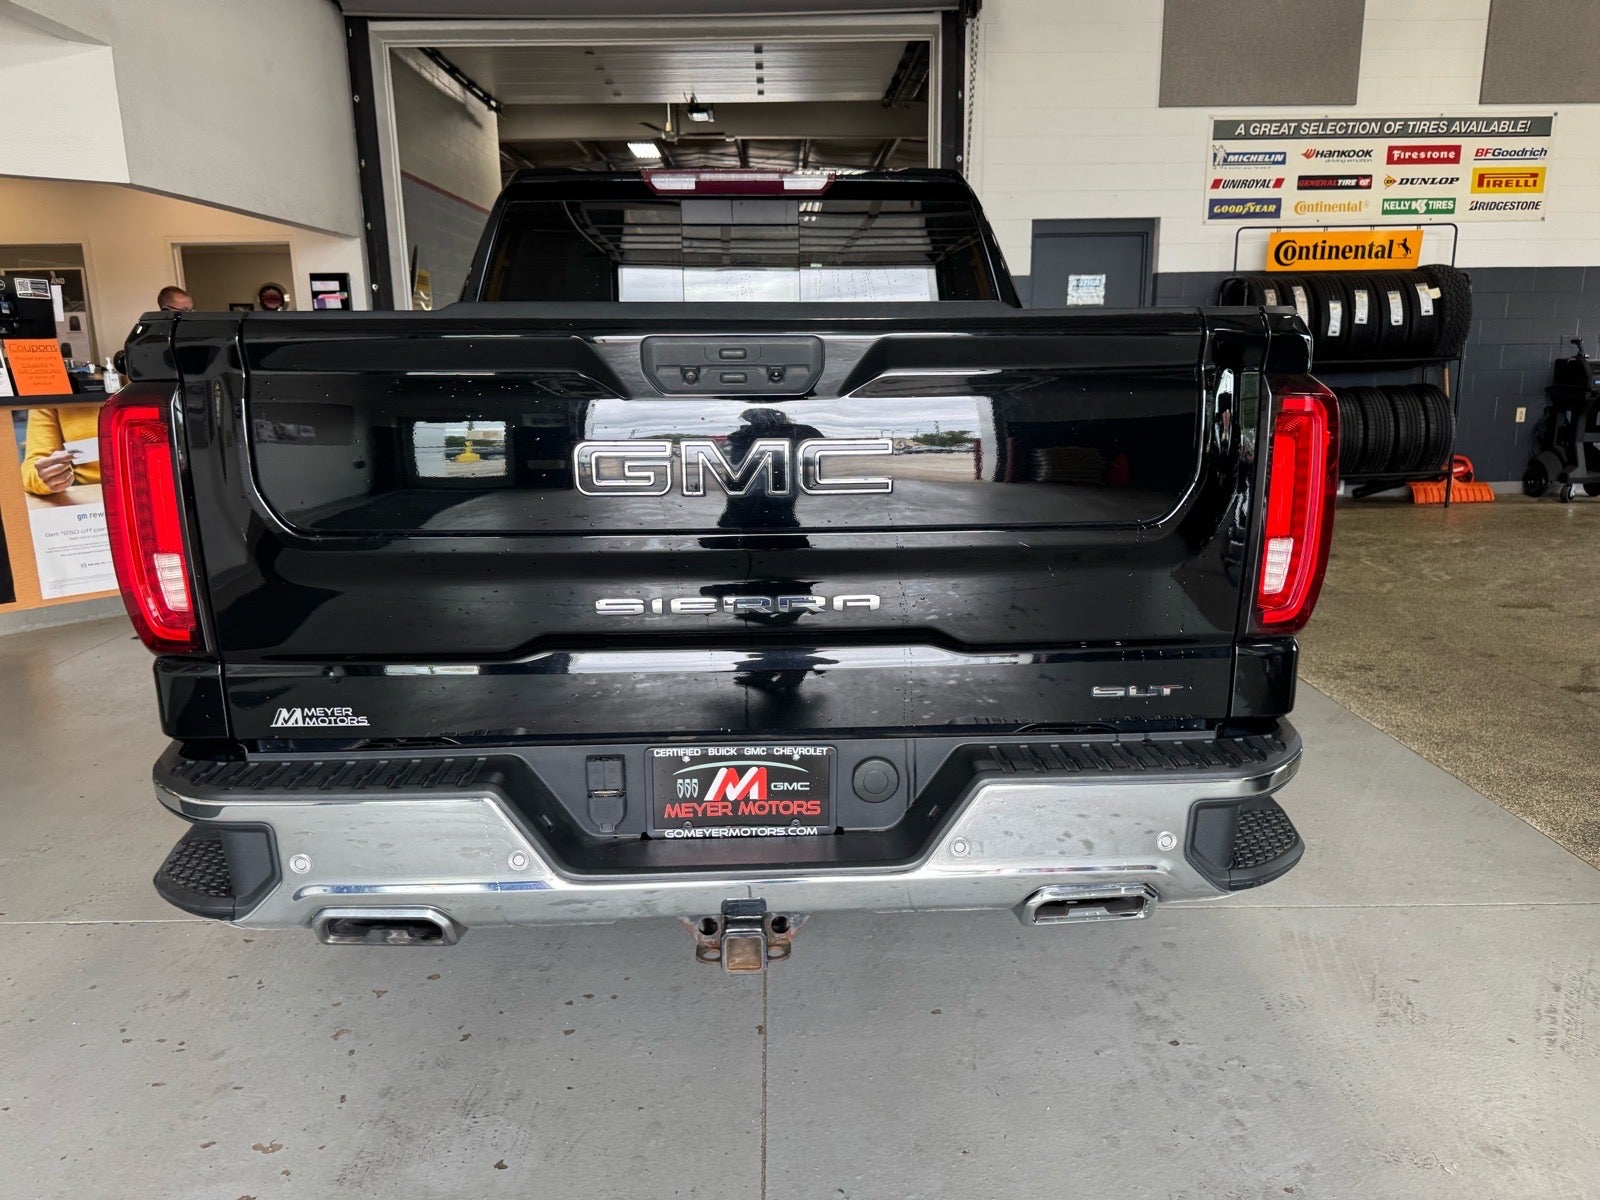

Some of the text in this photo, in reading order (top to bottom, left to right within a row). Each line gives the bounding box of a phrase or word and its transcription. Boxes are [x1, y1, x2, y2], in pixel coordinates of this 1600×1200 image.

[1235, 118, 1532, 135] A GREAT SELECTION OF TIRES AVAILABLE!
[1227, 153, 1284, 162] MICHELIN
[1392, 150, 1456, 161] Firestone
[1475, 147, 1548, 158] BFGoodrich
[1222, 178, 1271, 189] UNIROYAL
[1398, 177, 1460, 186] DUNLOP
[1477, 172, 1540, 188] PIRELLI
[1213, 202, 1277, 215] GOODYEAR
[1294, 200, 1363, 215] Continental
[1383, 201, 1412, 210] KELLY
[1428, 200, 1454, 210] TIRES
[1469, 200, 1543, 211] BRIDGESTONE
[1274, 239, 1394, 267] Continental
[8, 343, 58, 354] Coupons
[573, 439, 893, 496] GMC
[77, 513, 88, 521] gm
[595, 594, 881, 616] SIERRA
[1092, 684, 1184, 698] SLT
[304, 707, 353, 716] MEYER
[304, 716, 369, 726] MOTORS
[653, 746, 828, 757] CERTIFIED BUICK GMC CHEVROLET
[770, 781, 811, 791] GMC
[664, 800, 822, 819] MEYER MOTORS
[664, 826, 818, 839] GOMEYERMOTORS.COM
